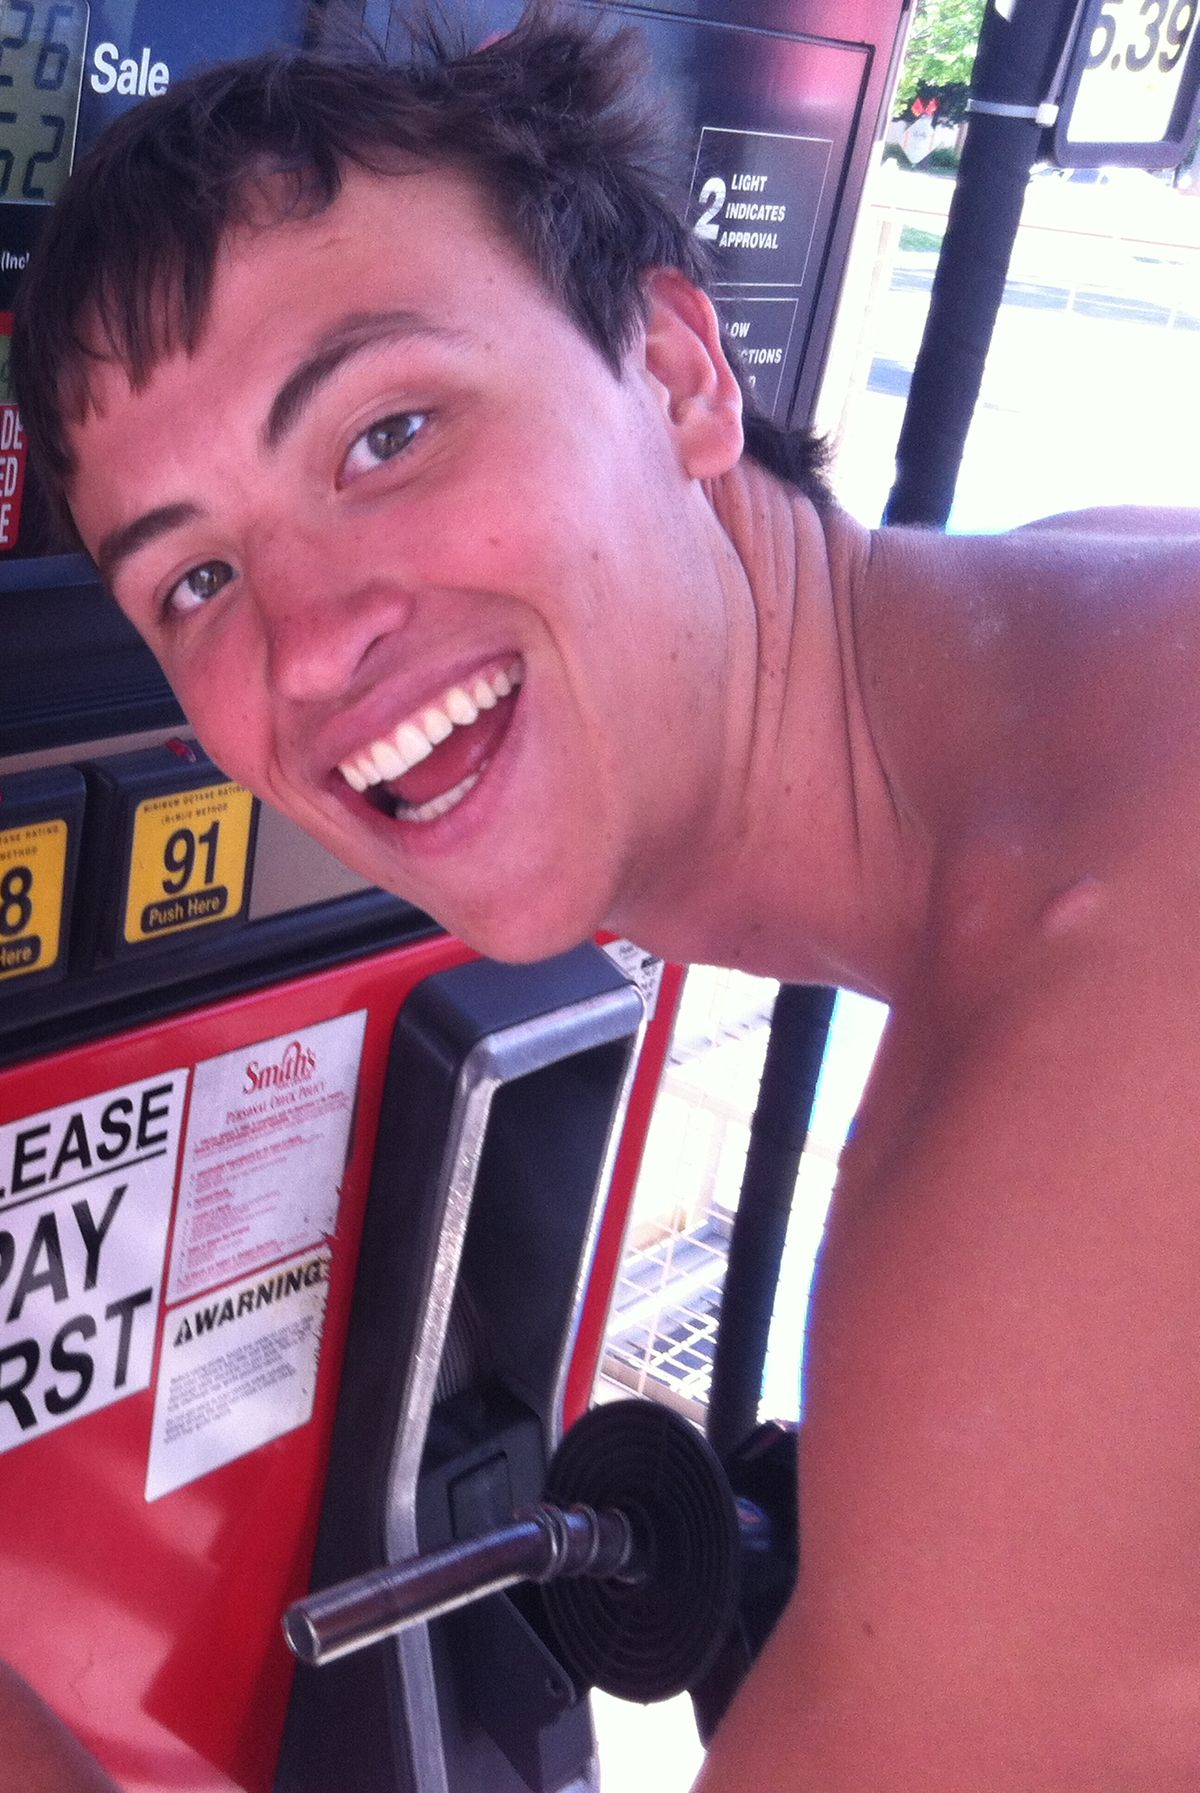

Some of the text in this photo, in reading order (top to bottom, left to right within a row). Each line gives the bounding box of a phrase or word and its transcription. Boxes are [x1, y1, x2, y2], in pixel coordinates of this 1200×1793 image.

[91, 43, 170, 97] Sale
[731, 174, 768, 192] LIGHT
[694, 177, 726, 240] 2
[725, 203, 786, 222] INDICATES
[719, 231, 779, 249] APPROVAL
[162, 819, 220, 895] 91
[149, 896, 220, 927] Push Here
[242, 1040, 317, 1095] Smith's
